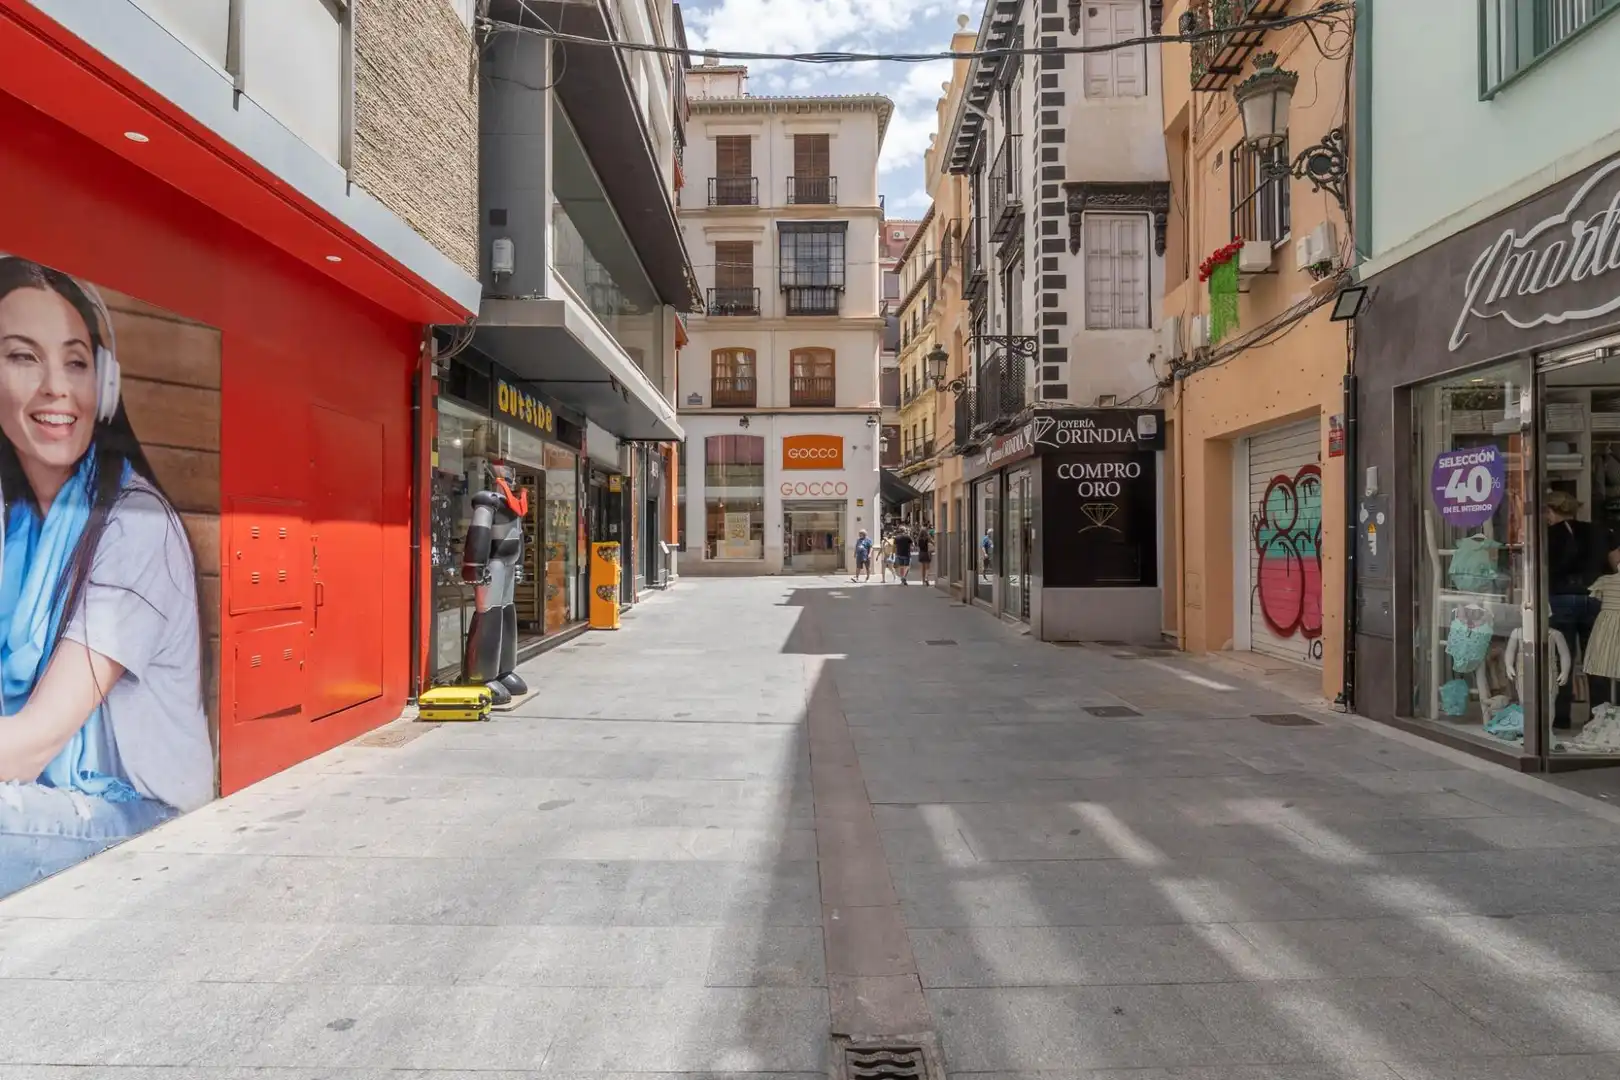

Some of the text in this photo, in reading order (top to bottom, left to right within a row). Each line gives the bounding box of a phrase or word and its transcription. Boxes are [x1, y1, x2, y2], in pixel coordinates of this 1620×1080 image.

[1057, 418, 1096, 429] JOYERÍA
[788, 447, 838, 459] GOCCO
[1438, 449, 1495, 468] SELECCIÓN
[1057, 462, 1141, 479] COMPRO
[780, 481, 848, 496] GOCCO
[1078, 481, 1121, 498] ORO
[1442, 503, 1493, 514] EN EL INTERIOR
